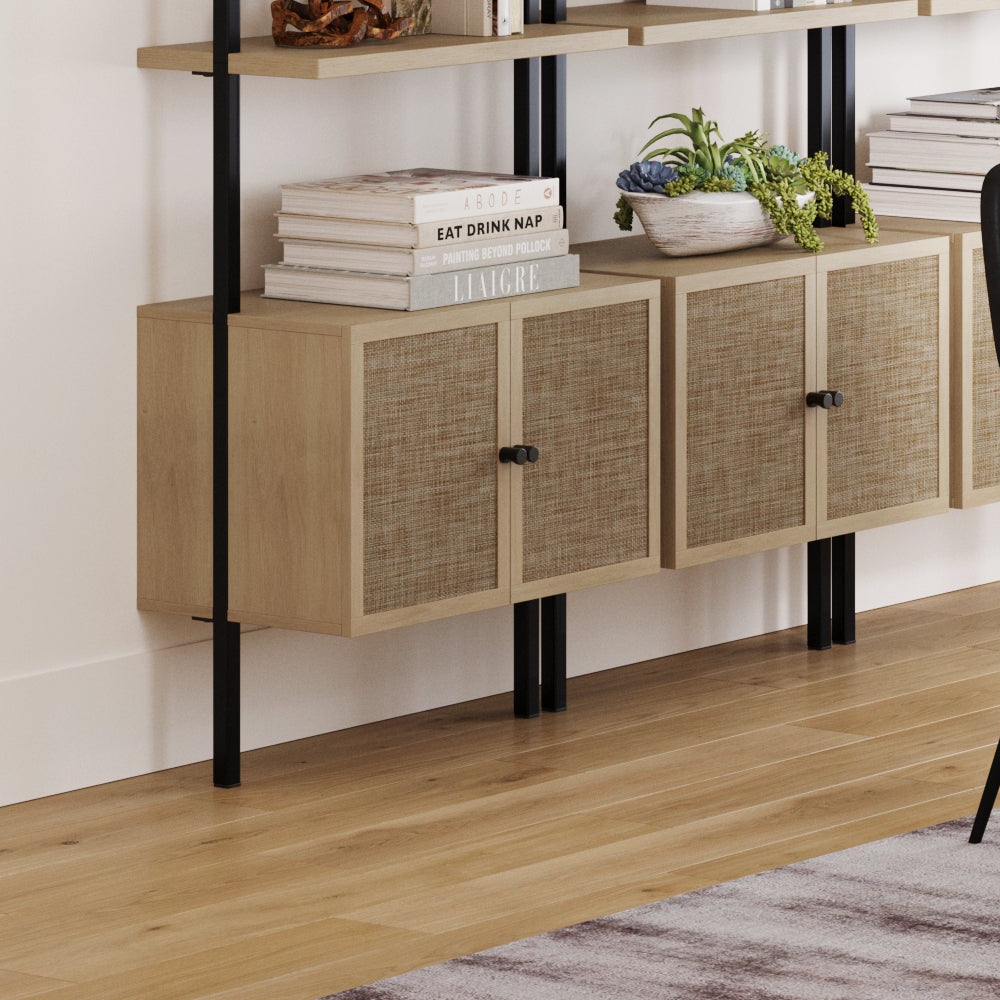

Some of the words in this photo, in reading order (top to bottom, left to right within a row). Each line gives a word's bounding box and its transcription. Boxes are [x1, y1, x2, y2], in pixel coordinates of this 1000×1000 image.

[463, 187, 522, 211] ABODE
[436, 225, 463, 241] EAT
[466, 218, 511, 237] DRINK
[513, 214, 544, 231] NAP
[442, 251, 481, 266] PAINTING
[481, 245, 514, 260] BEYOND
[515, 239, 552, 256] POLLOCK
[453, 263, 540, 303] LIAIGRE
